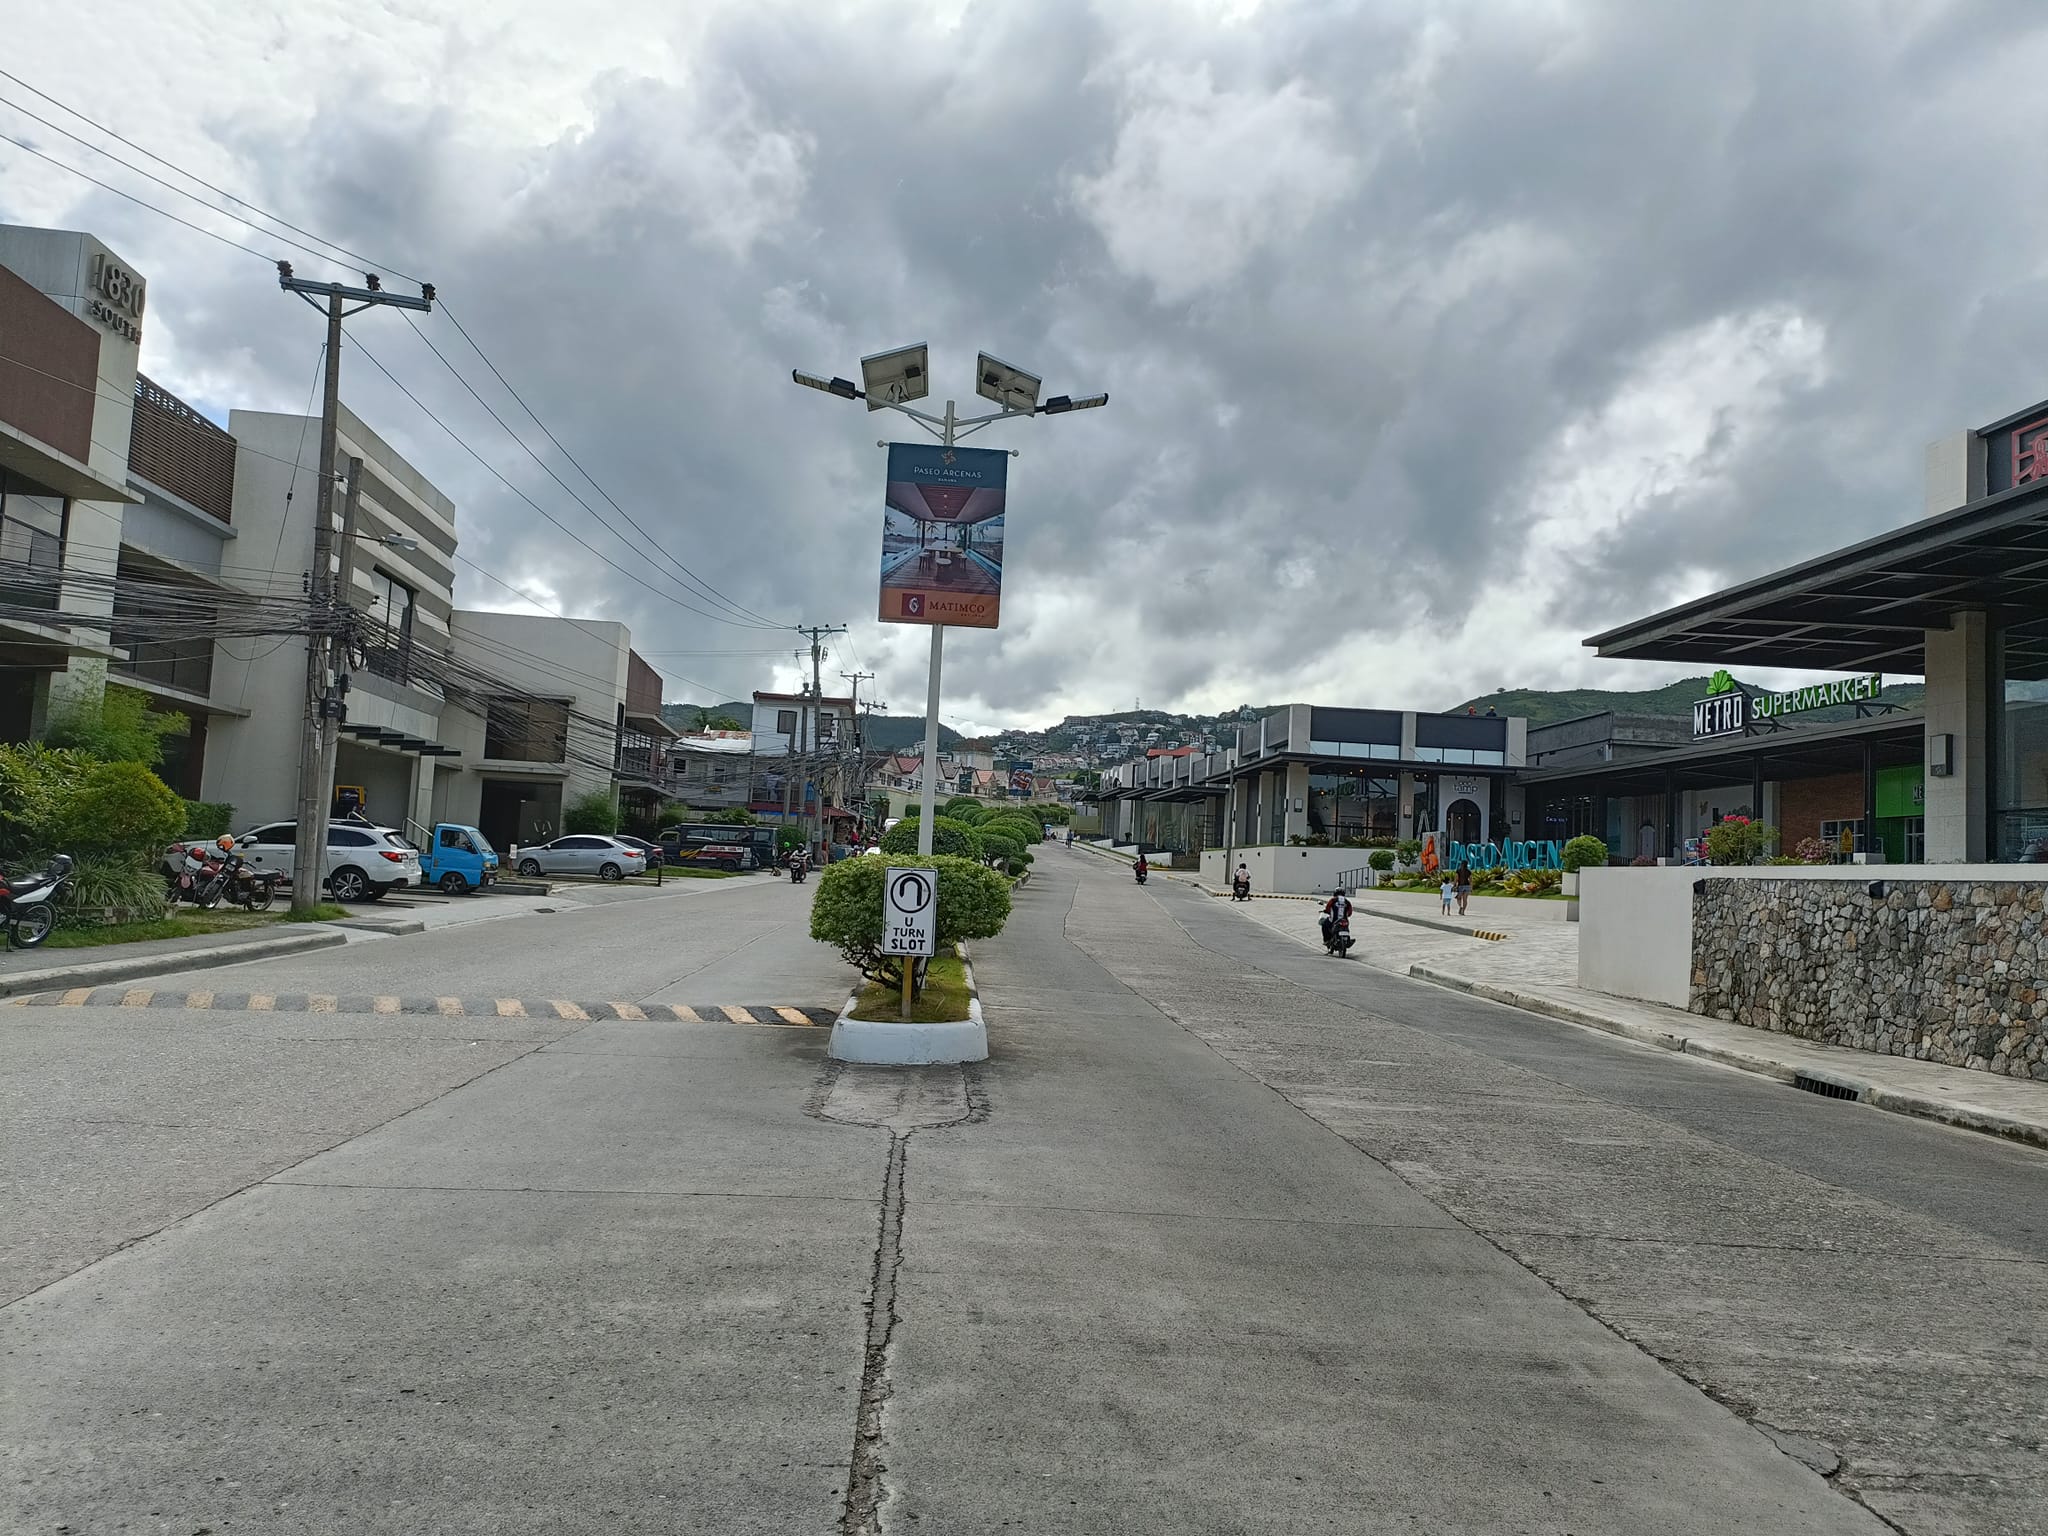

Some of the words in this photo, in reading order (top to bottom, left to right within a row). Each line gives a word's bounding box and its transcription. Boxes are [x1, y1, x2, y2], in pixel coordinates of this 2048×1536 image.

[97, 253, 143, 318] 1830
[93, 299, 142, 345] SOUTH
[914, 466, 941, 476] PASEO
[942, 468, 982, 478] ARCENAS
[929, 601, 985, 614] MATIMCO
[1693, 695, 1743, 735] METRO
[1752, 673, 1876, 720] SUPERMARKET
[1449, 840, 1498, 870] PASEO
[1500, 836, 1565, 870] ARCEN
[904, 916, 914, 927] U
[893, 927, 925, 938] TURN
[891, 938, 926, 951] SLOT
